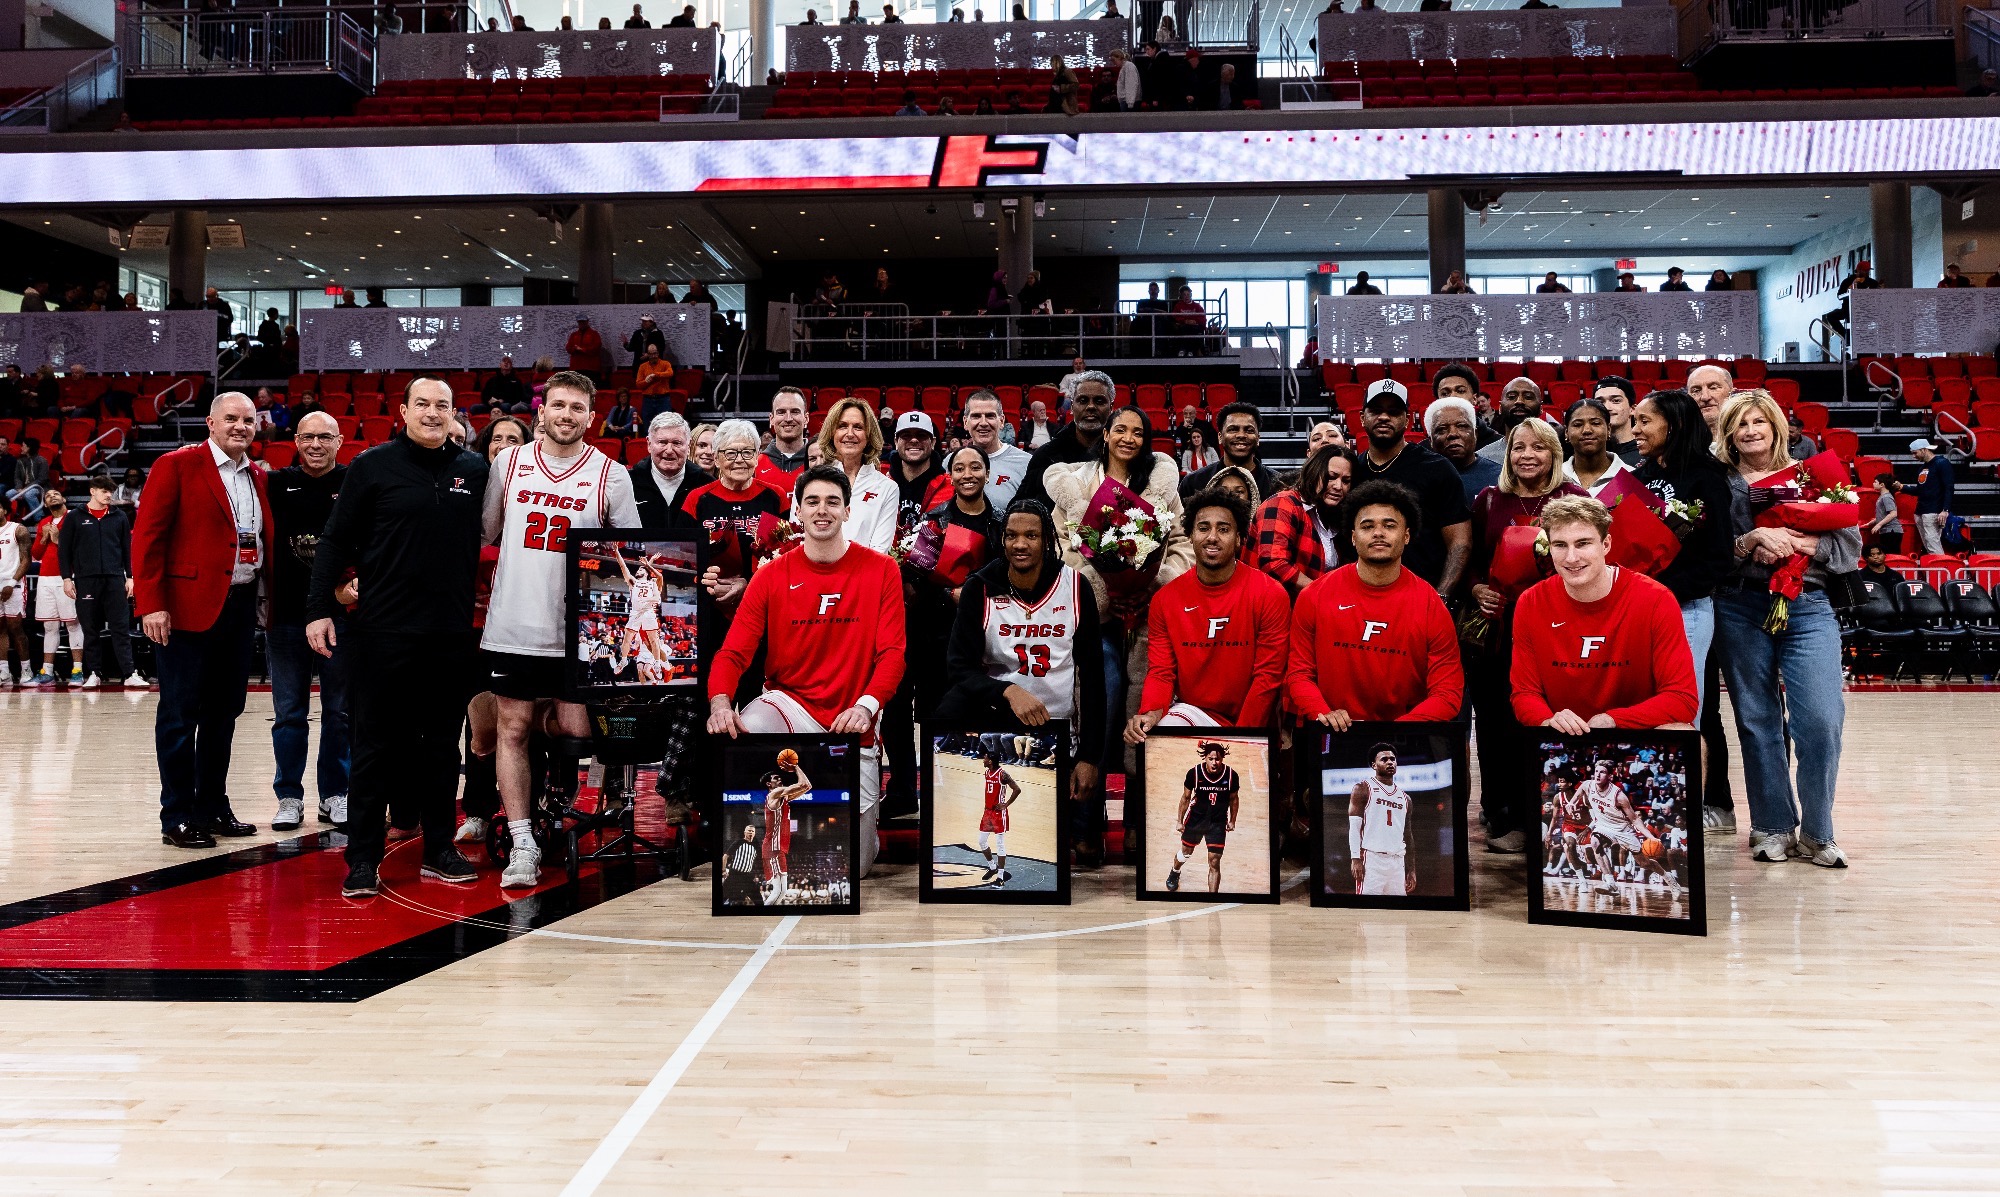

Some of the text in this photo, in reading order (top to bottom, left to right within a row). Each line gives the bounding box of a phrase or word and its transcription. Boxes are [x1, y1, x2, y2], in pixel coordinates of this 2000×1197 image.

[1797, 255, 1842, 303] QUICK
[996, 475, 1010, 485] F
[517, 490, 587, 511] STAGS
[862, 492, 878, 502] F
[524, 511, 571, 553] 22
[1907, 584, 1923, 595] F
[1957, 584, 1974, 595] F
[819, 593, 842, 615] F
[999, 624, 1066, 637] STAGS
[1207, 617, 1230, 639] F
[1361, 620, 1388, 641] F
[1333, 641, 1407, 656] BASKETBALL
[1580, 636, 1606, 658] F
[1014, 644, 1051, 677] 13
[1209, 793, 1217, 805] 4
[1376, 798, 1403, 810] STAGS
[1387, 810, 1392, 826] 1
